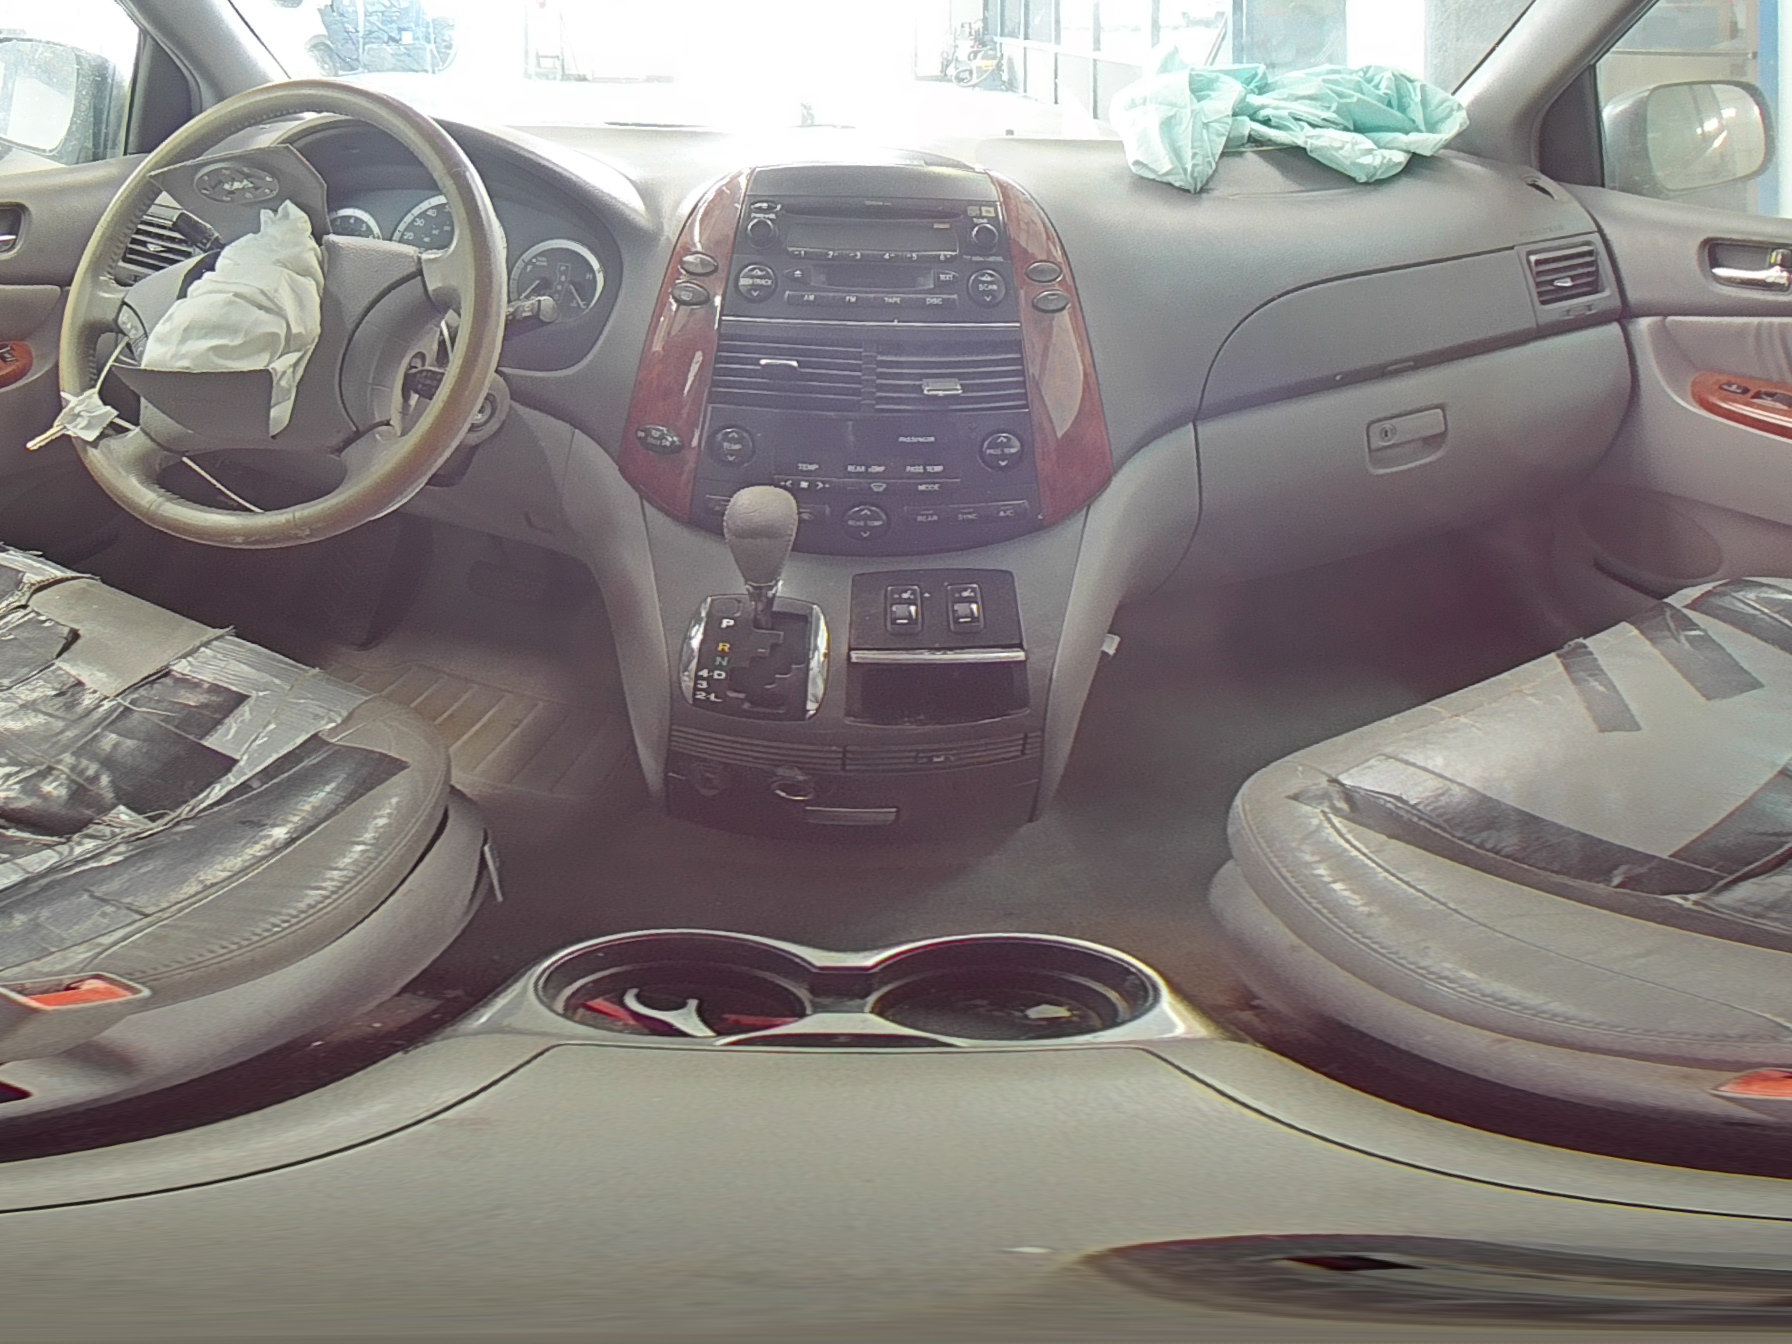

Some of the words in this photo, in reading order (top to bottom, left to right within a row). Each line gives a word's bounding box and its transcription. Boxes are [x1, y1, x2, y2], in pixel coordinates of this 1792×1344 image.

[926, 297, 943, 305] DISC
[797, 463, 819, 471] TEMP
[999, 509, 1015, 517] A/C
[720, 618, 735, 629] P
[716, 642, 731, 652] R
[714, 656, 729, 666] N
[696, 680, 708, 689] 3
